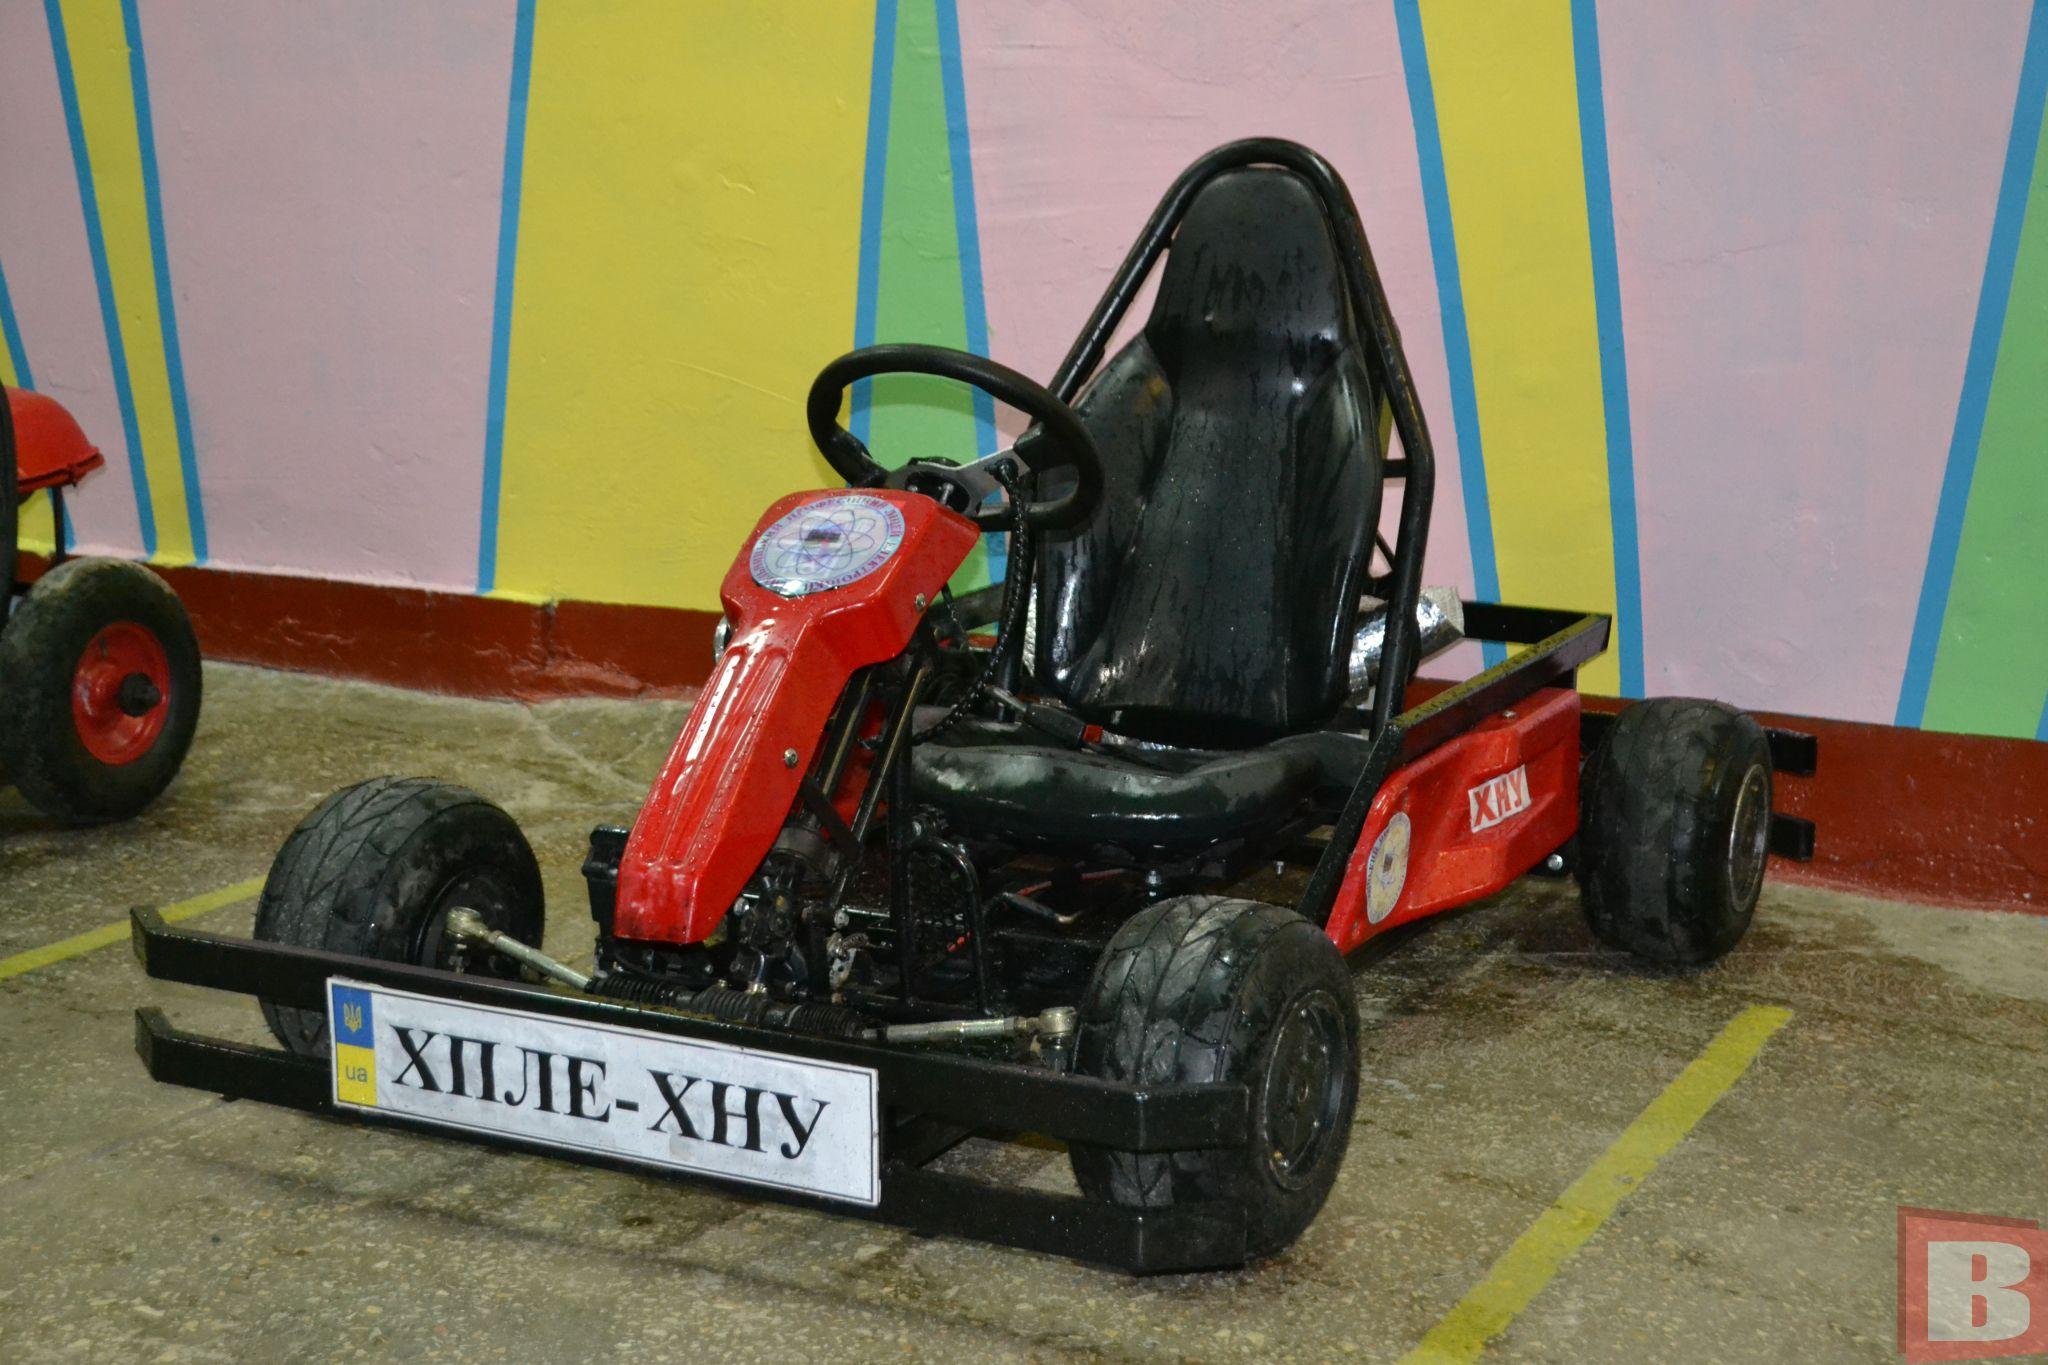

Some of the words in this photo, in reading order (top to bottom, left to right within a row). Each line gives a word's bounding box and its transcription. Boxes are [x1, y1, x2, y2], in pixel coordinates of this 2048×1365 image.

[1474, 768, 1524, 826] ХНУ
[345, 1064, 369, 1084] ua
[389, 1024, 831, 1159] ХПЛЕ-ХНУ
